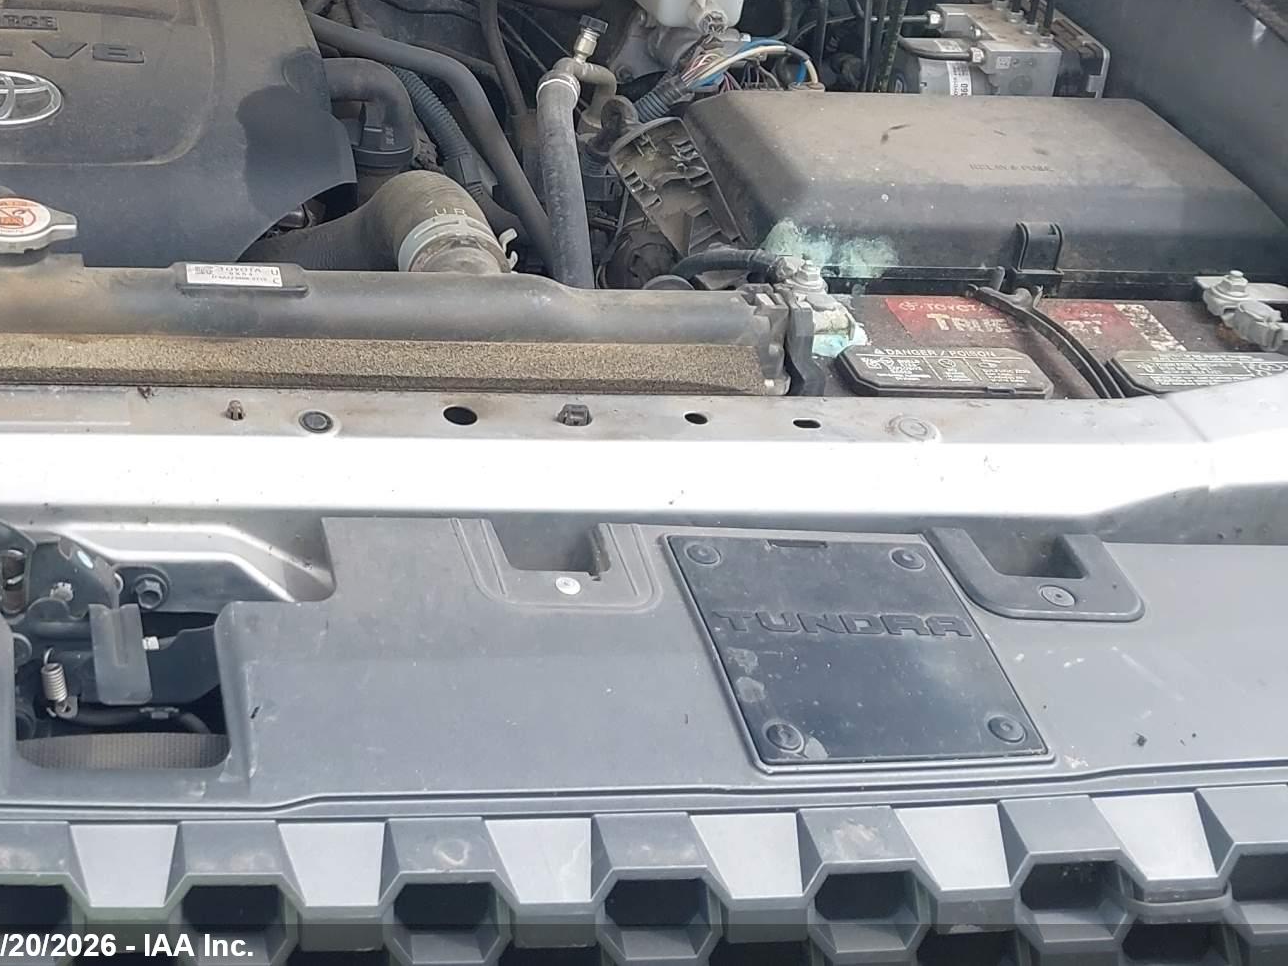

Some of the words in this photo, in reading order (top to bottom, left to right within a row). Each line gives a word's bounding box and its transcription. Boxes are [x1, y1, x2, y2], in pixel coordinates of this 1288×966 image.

[31, 39, 146, 64] V8
[883, 348, 938, 357] DANGER
[949, 349, 997, 358] POISON
[712, 611, 972, 637] TUNDRA
